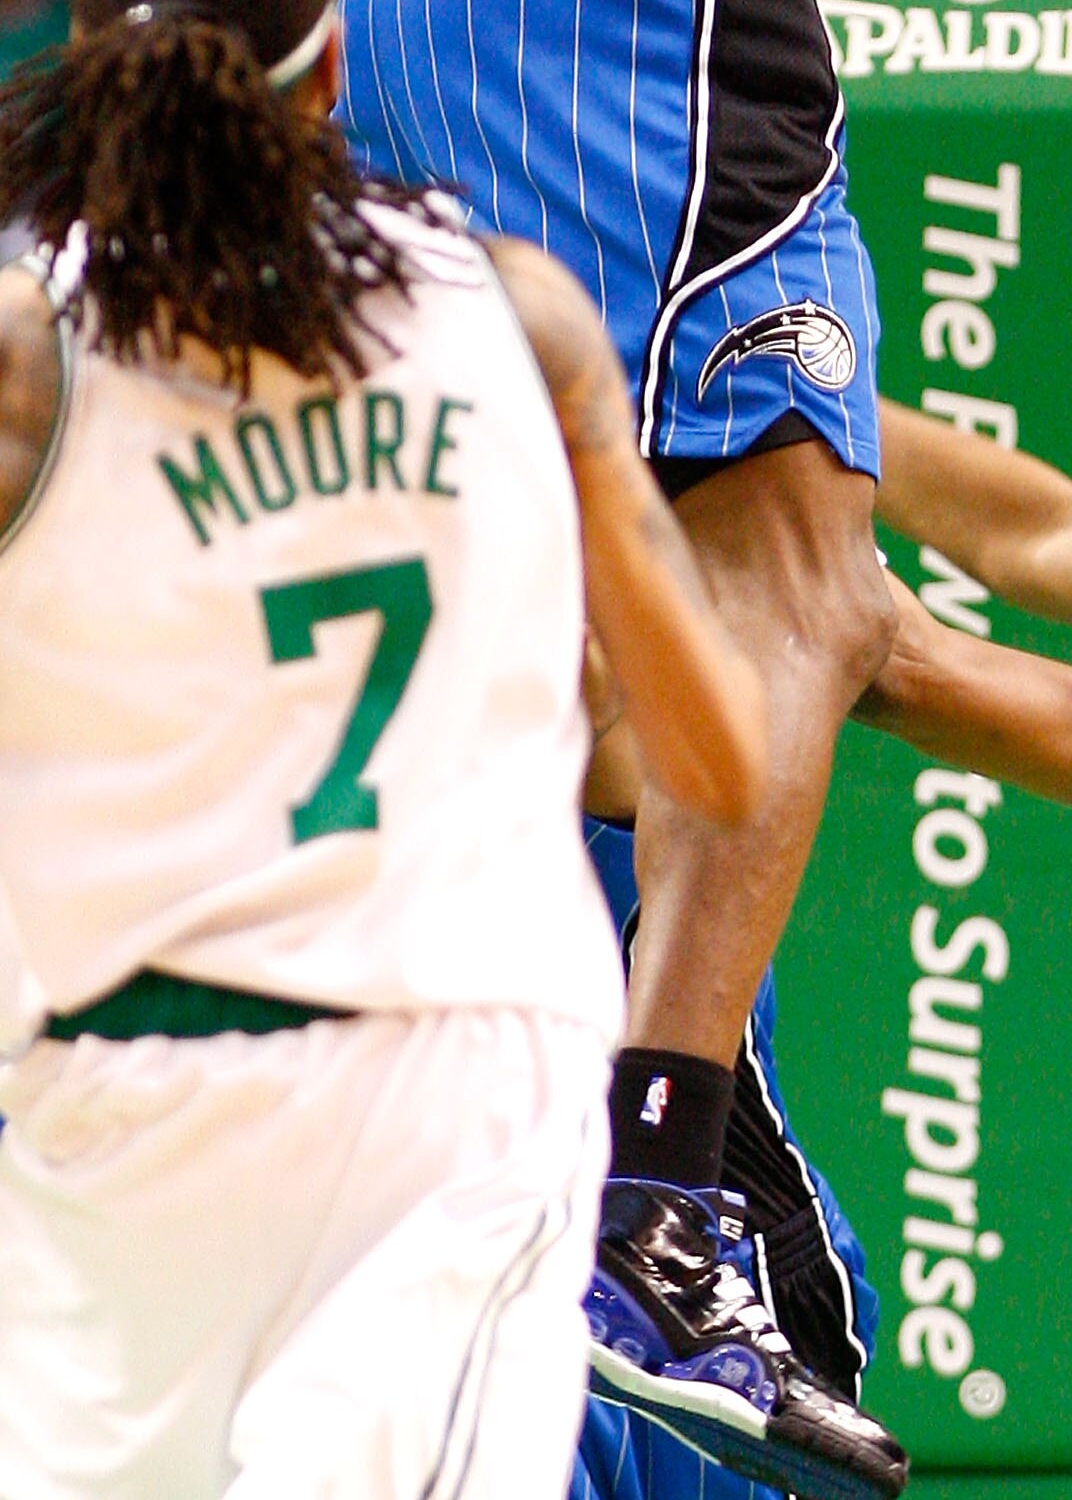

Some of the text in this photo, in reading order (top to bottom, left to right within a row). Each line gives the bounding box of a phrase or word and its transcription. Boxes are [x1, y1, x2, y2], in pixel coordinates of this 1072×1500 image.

[921, 162, 1021, 370] The
[157, 390, 474, 547] MOORE
[256, 552, 435, 848] 7
[911, 767, 1003, 887] to
